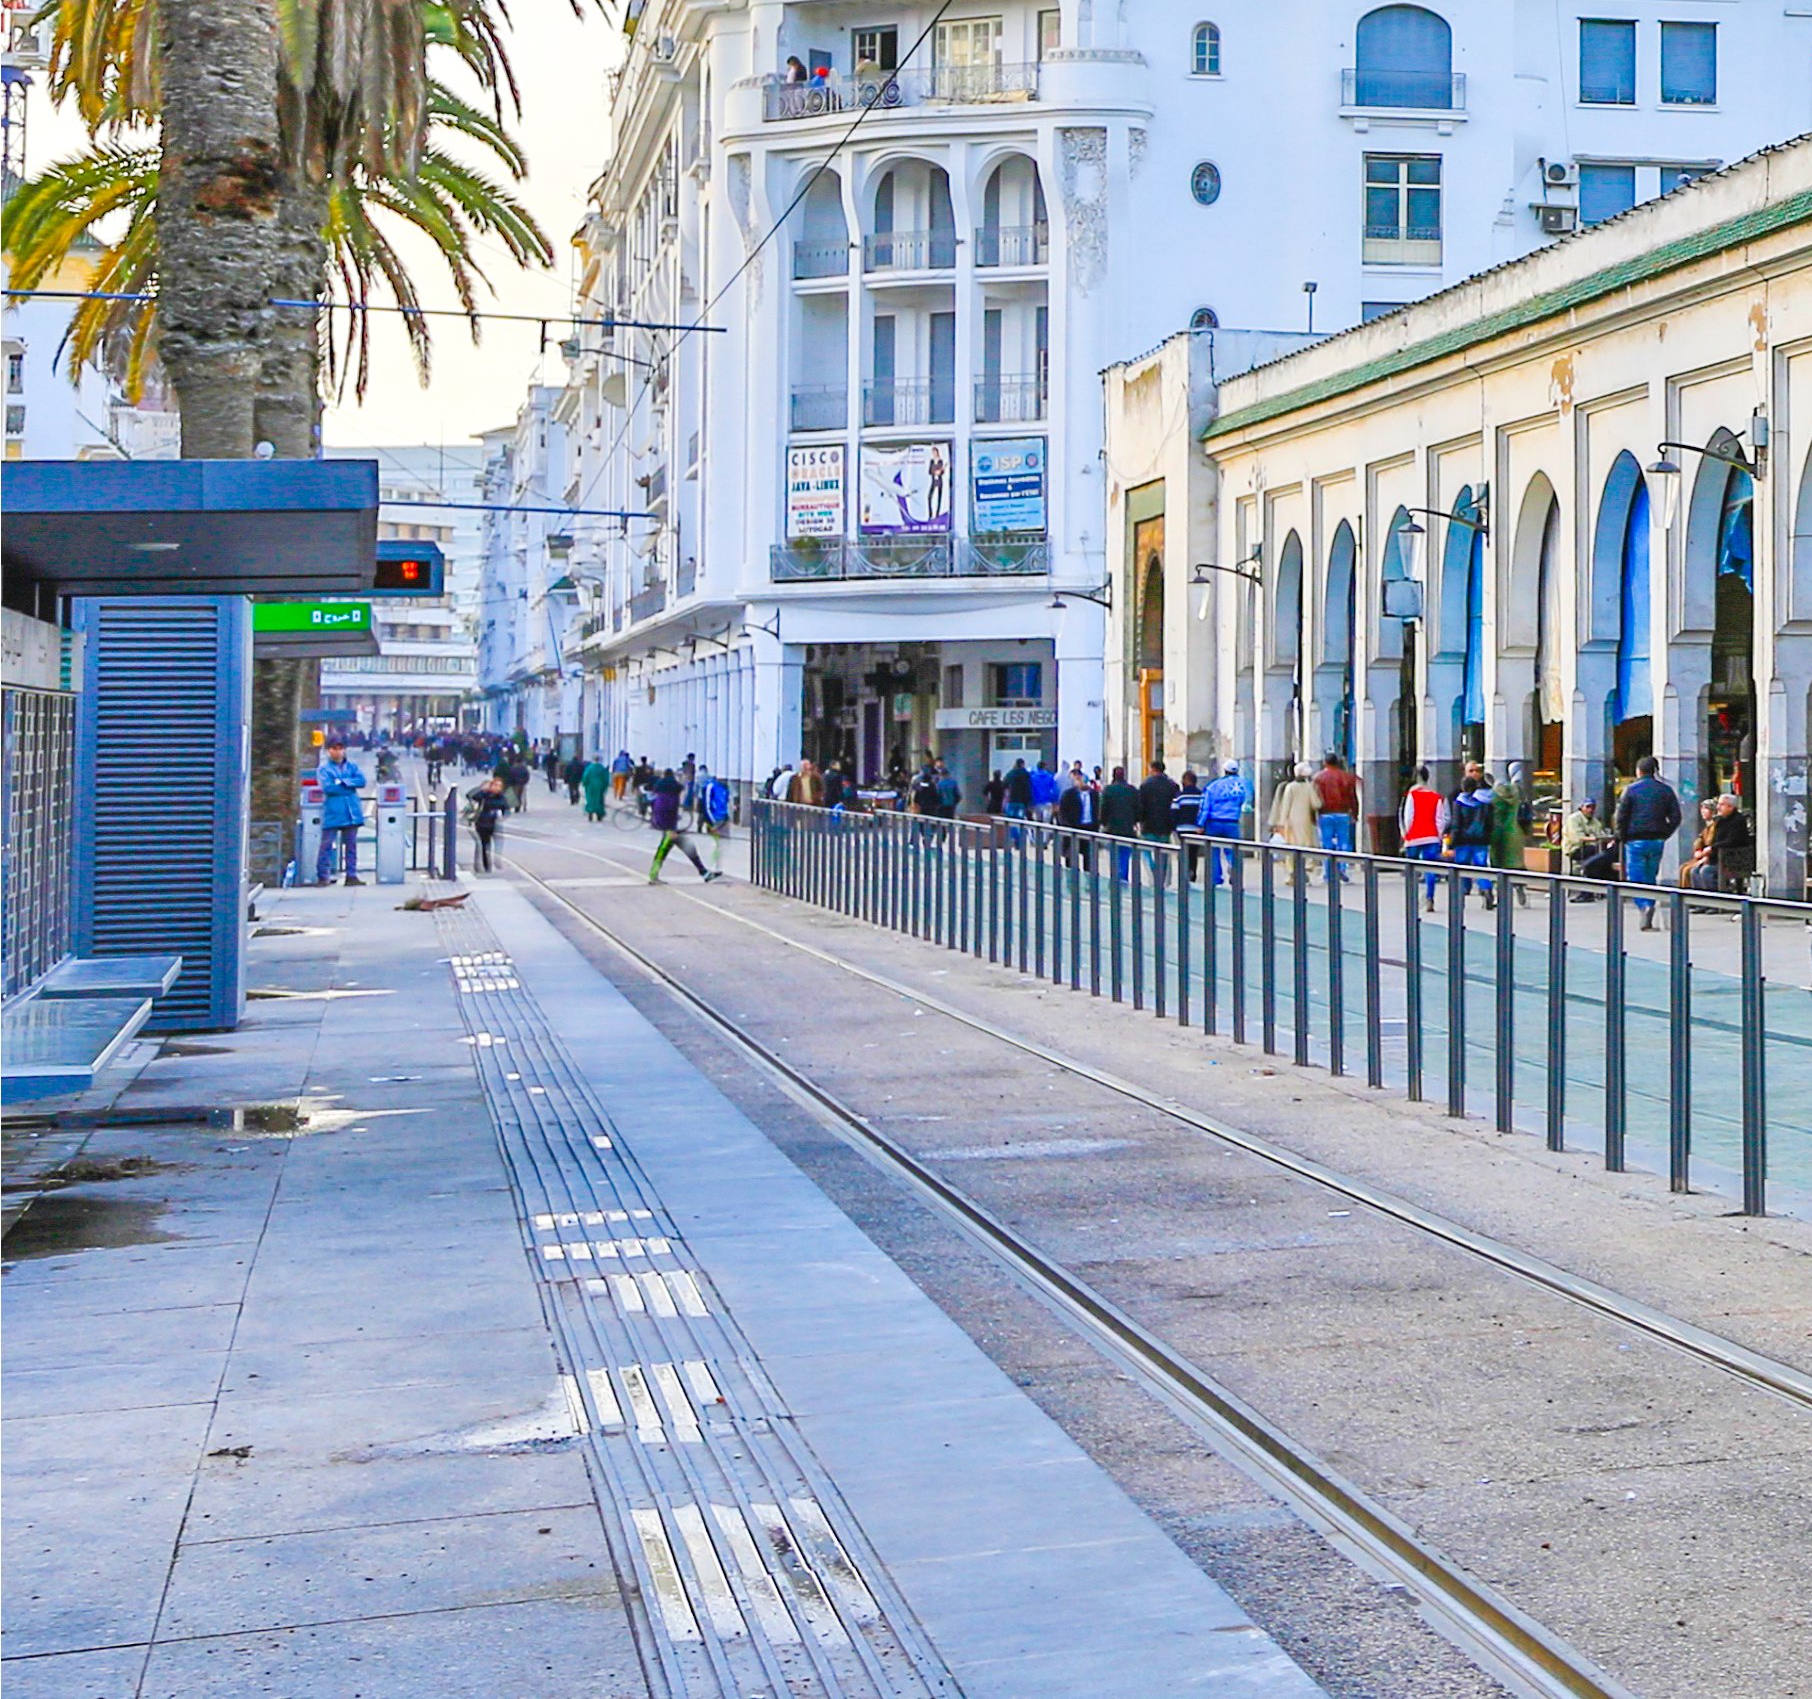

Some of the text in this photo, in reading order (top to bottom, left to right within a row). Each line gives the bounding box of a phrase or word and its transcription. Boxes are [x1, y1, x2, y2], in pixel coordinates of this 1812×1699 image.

[792, 451, 839, 466] CISCO
[994, 455, 1024, 471] ISP
[969, 710, 998, 726] CAFE
[1003, 710, 1024, 726] LES
